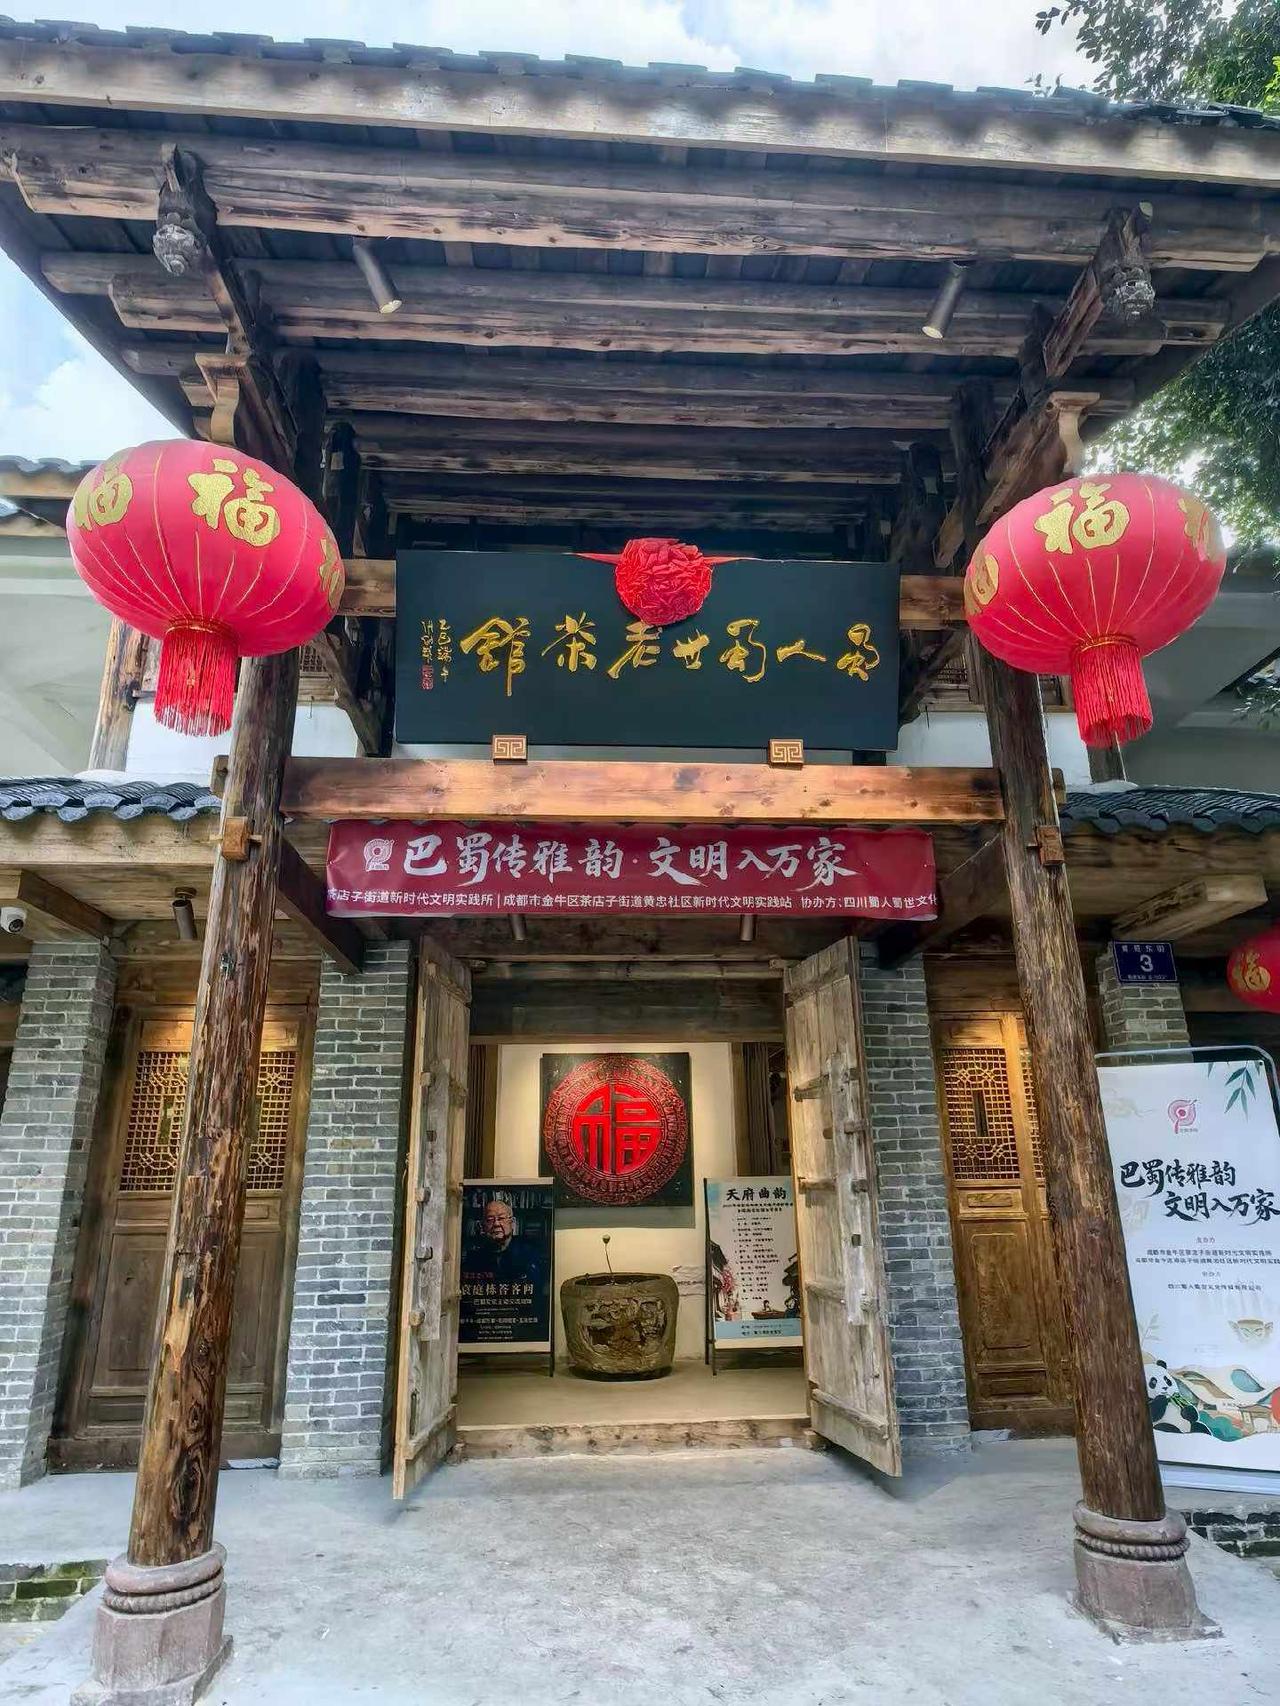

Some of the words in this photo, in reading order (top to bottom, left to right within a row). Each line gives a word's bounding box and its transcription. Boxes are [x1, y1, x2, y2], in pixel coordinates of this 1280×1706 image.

[187, 458, 281, 547] 福
[1034, 481, 1131, 556] 福
[1140, 954, 1154, 972] 3
[572, 1080, 662, 1175] 福
[726, 1186, 787, 1202] 天府曲韵
[1119, 1158, 1236, 1198] 巴蜀传雅韵
[1163, 1188, 1280, 1227] 文明入万家
